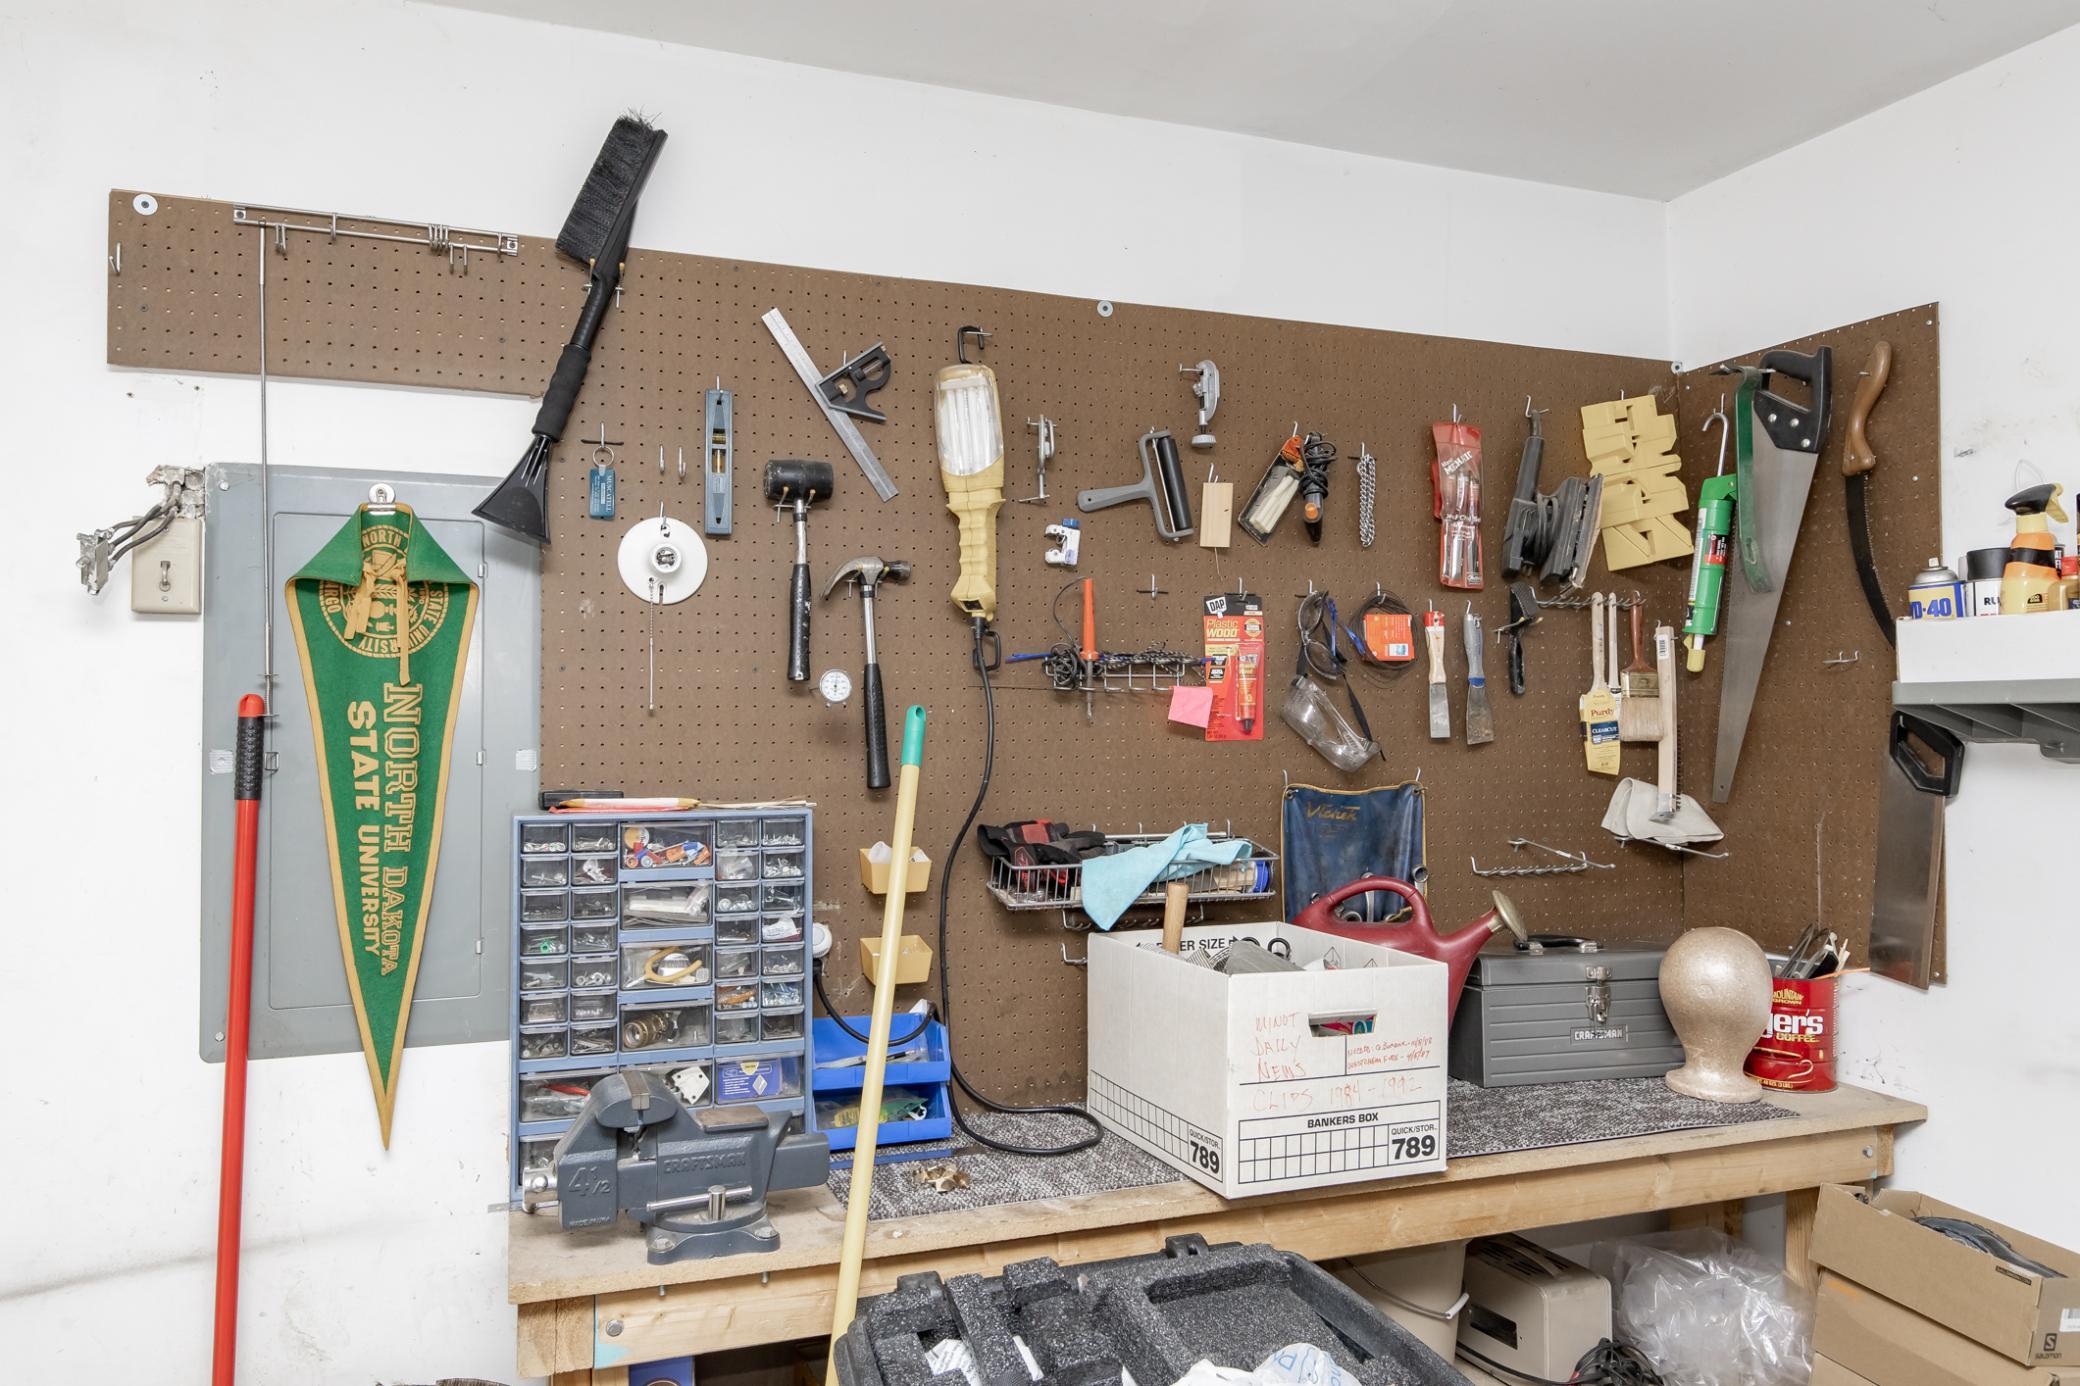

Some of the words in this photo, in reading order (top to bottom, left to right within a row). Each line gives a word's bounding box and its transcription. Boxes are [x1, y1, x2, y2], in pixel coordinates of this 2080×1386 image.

[362, 529, 402, 548] NORTH
[427, 590, 443, 625] STATE
[1209, 599, 1225, 612] DAP
[1910, 598, 1953, 620] D-40
[1206, 618, 1239, 630] Plastic
[1206, 629, 1239, 638] WOOD
[357, 623, 431, 651] UNIRSITY
[1590, 707, 1615, 718] Purdy
[1591, 726, 1618, 735] CLEARCUT
[347, 700, 381, 812] STATE
[383, 682, 424, 853] NORTH
[357, 823, 381, 957] UNIVERSITY
[380, 865, 409, 977] DAKOTA
[1198, 938, 1226, 951] SIZE
[1256, 1012, 1299, 1032] MINOT
[1761, 1009, 1824, 1039] ger's
[1775, 1032, 1818, 1043] COFFEE
[1307, 1114, 1356, 1128] BANKERS
[1358, 1112, 1379, 1124] BOX
[1189, 1141, 1220, 1174] 789
[1391, 1134, 1436, 1160] 789
[663, 1151, 746, 1174] CRAFTSMAN
